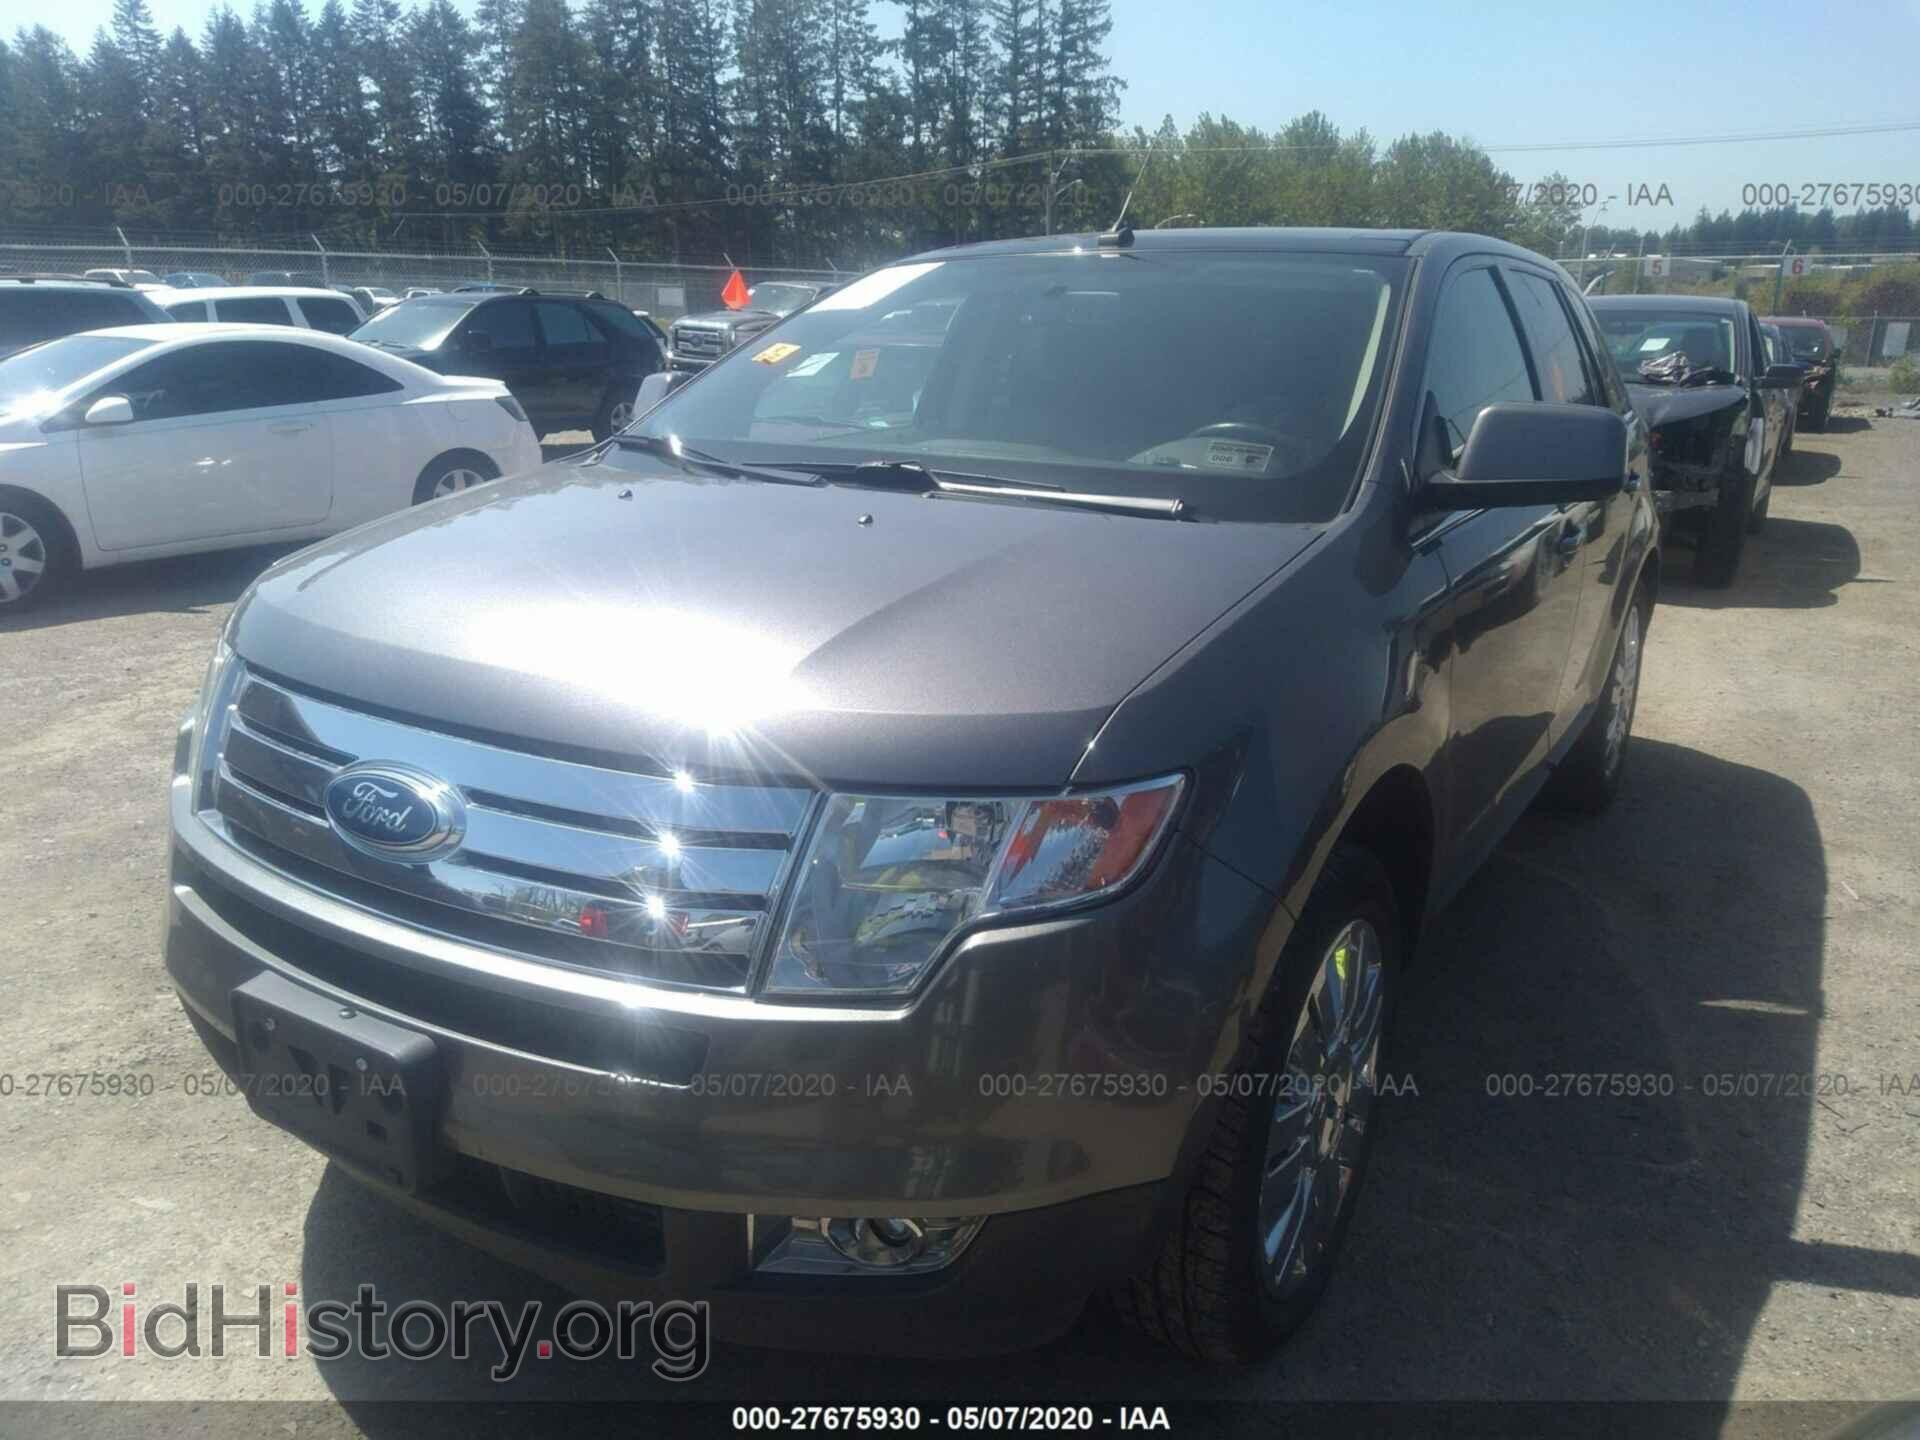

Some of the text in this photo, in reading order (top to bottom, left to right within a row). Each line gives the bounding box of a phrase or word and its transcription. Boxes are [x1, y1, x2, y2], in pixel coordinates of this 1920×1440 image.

[1652, 260, 1662, 274] 5
[1792, 259, 1804, 274] 6
[343, 781, 413, 832] Ford
